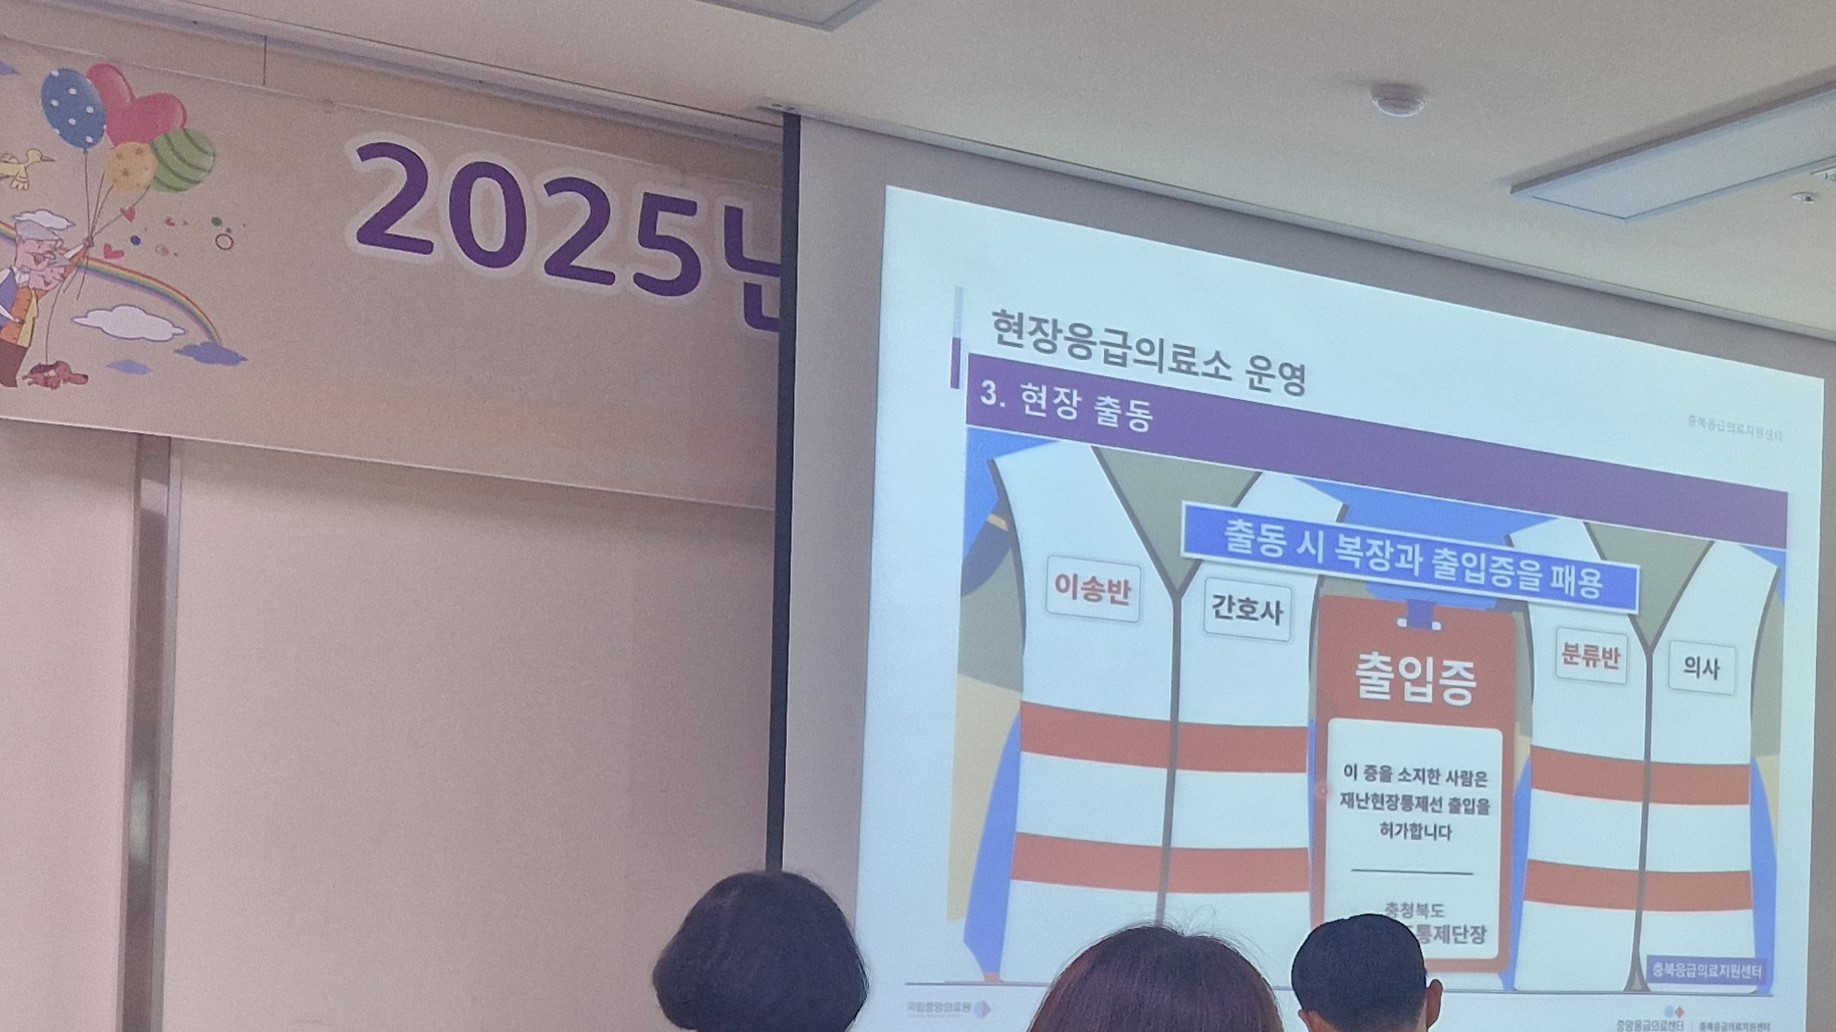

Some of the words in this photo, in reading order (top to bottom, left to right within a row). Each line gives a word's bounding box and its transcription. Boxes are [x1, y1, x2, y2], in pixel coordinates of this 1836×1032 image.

[990, 308, 1233, 382] 현장응급의료소
[1245, 354, 1306, 397] 운영
[980, 380, 1005, 408] 3.
[1020, 382, 1082, 421] 현장
[1094, 395, 1154, 433] 출동
[1223, 518, 1288, 558] 출동
[1297, 530, 1325, 564] 시
[1335, 534, 1423, 577] 복장과
[1431, 551, 1543, 592] 출입증을
[1550, 563, 1604, 600] 패용
[1054, 573, 1133, 607] 이송반
[1211, 593, 1285, 627] 간호사
[1561, 641, 1622, 671] 분류반
[1683, 656, 1721, 681] 의사
[1354, 651, 1478, 707] 출입증
[1343, 763, 1359, 782] 이
[1363, 764, 1393, 784] 증을
[1397, 767, 1441, 786] 소지한
[1445, 769, 1489, 789] 사람은
[1339, 791, 1444, 814] 재난현장통제선
[1448, 797, 1491, 817] 출입을
[1379, 821, 1453, 842] 허가합니다
[1384, 901, 1445, 920] 충청북도
[1406, 923, 1488, 946] 통제단장
[1652, 961, 1763, 980] 충북응급의료지원센터
[1616, 1019, 1685, 1032] 중앙응급의료센터
